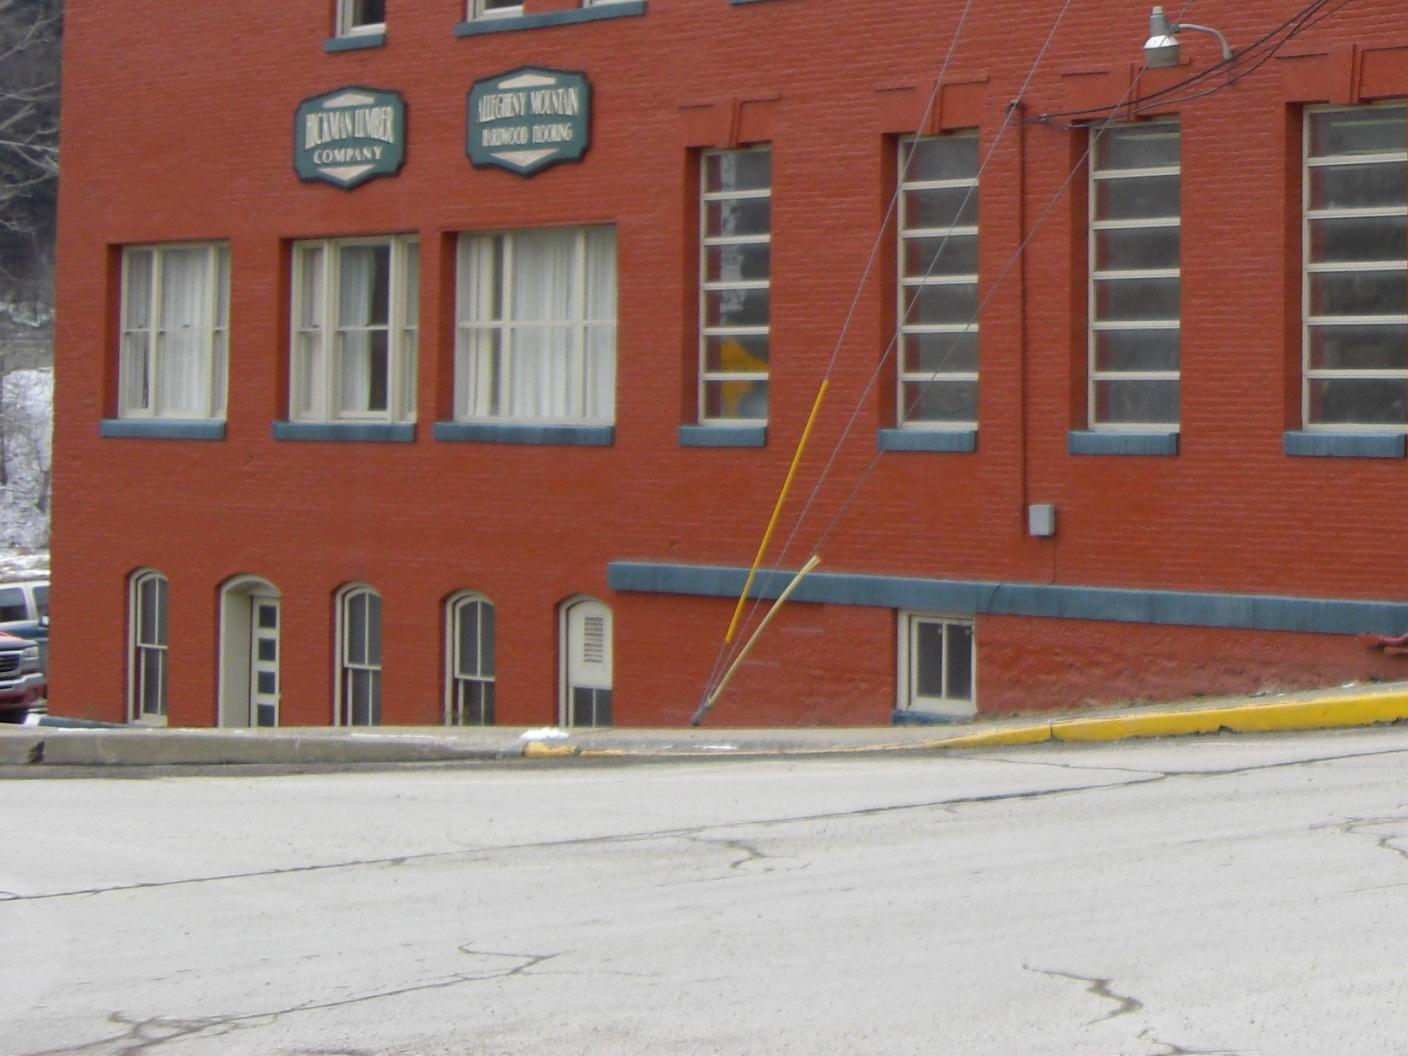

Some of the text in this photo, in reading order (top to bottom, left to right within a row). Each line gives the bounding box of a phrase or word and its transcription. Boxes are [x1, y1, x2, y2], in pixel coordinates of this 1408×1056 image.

[477, 87, 579, 123] ALLEGHENY MOUNTAIN
[305, 106, 394, 151] HICKMAN LUMBER
[481, 123, 573, 147] HARDWOOD FLOORING
[313, 145, 383, 165] COMPANY
